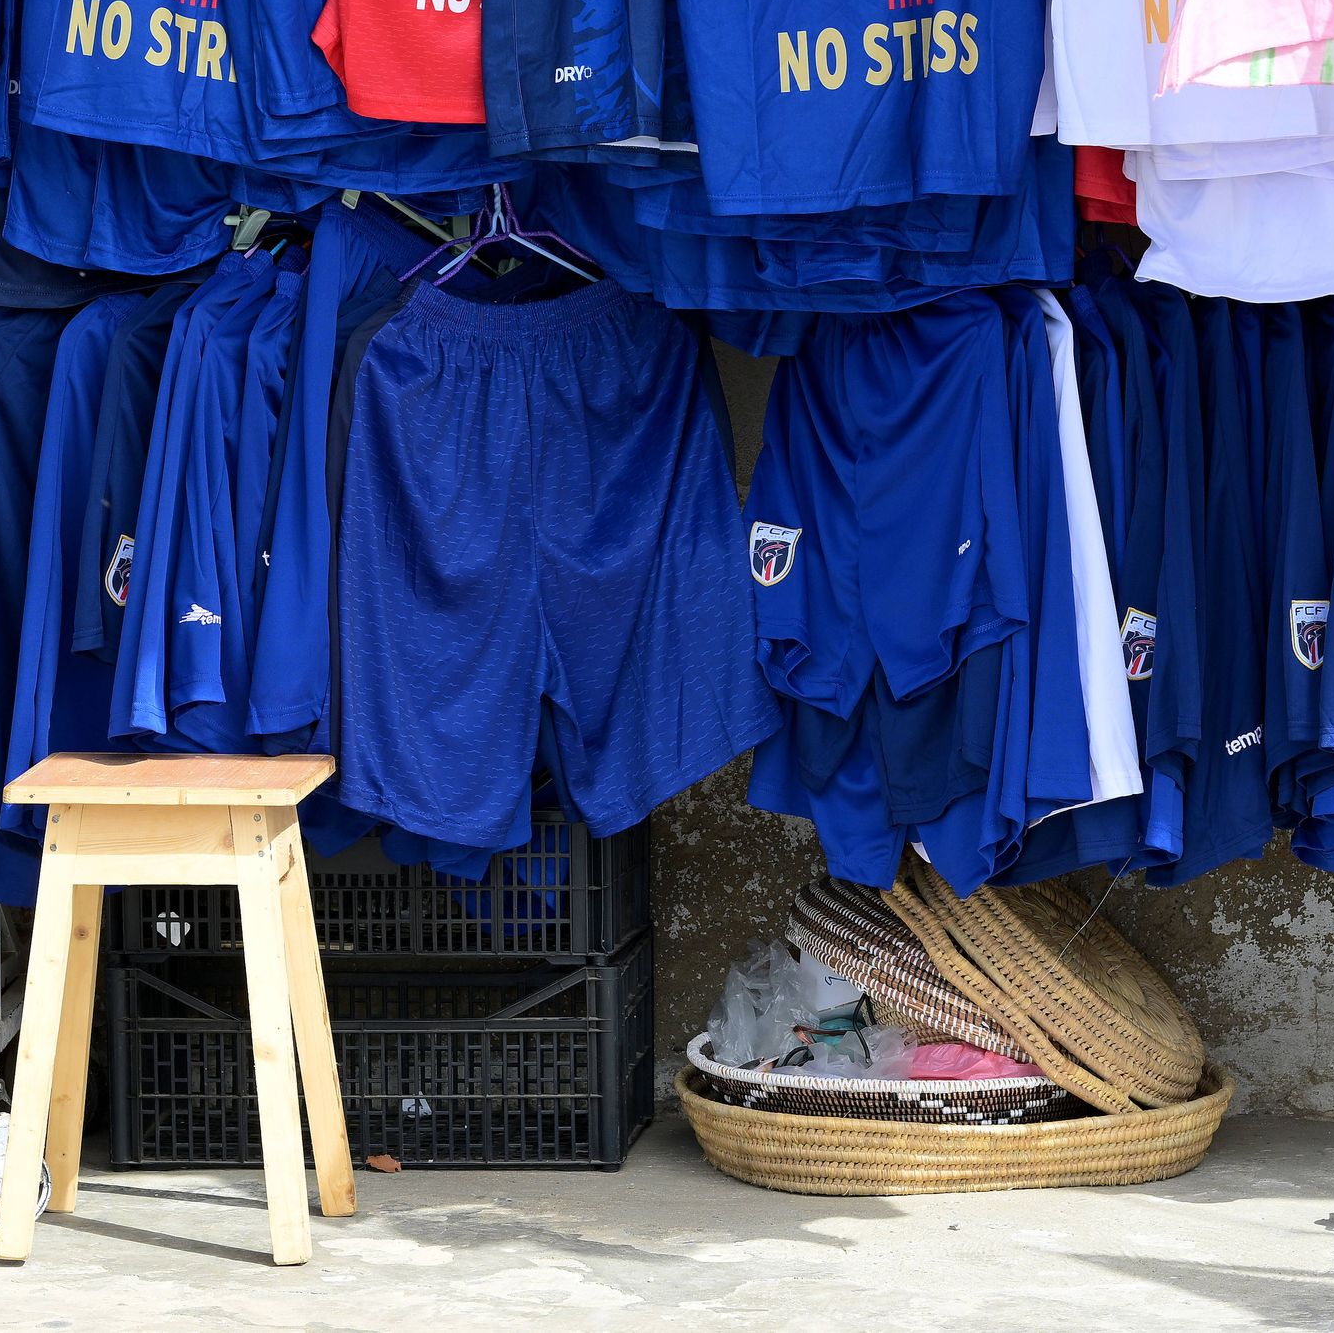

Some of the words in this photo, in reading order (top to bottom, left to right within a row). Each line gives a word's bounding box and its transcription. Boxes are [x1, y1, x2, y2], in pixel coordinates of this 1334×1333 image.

[144, 5, 237, 84] STR
[776, 26, 848, 94] NO
[863, 10, 978, 85] STSS
[555, 65, 585, 84] DRY
[756, 525, 795, 537] FCF
[1295, 606, 1326, 616] FCF
[1130, 617, 1157, 630] FC
[1225, 724, 1264, 756] temp
